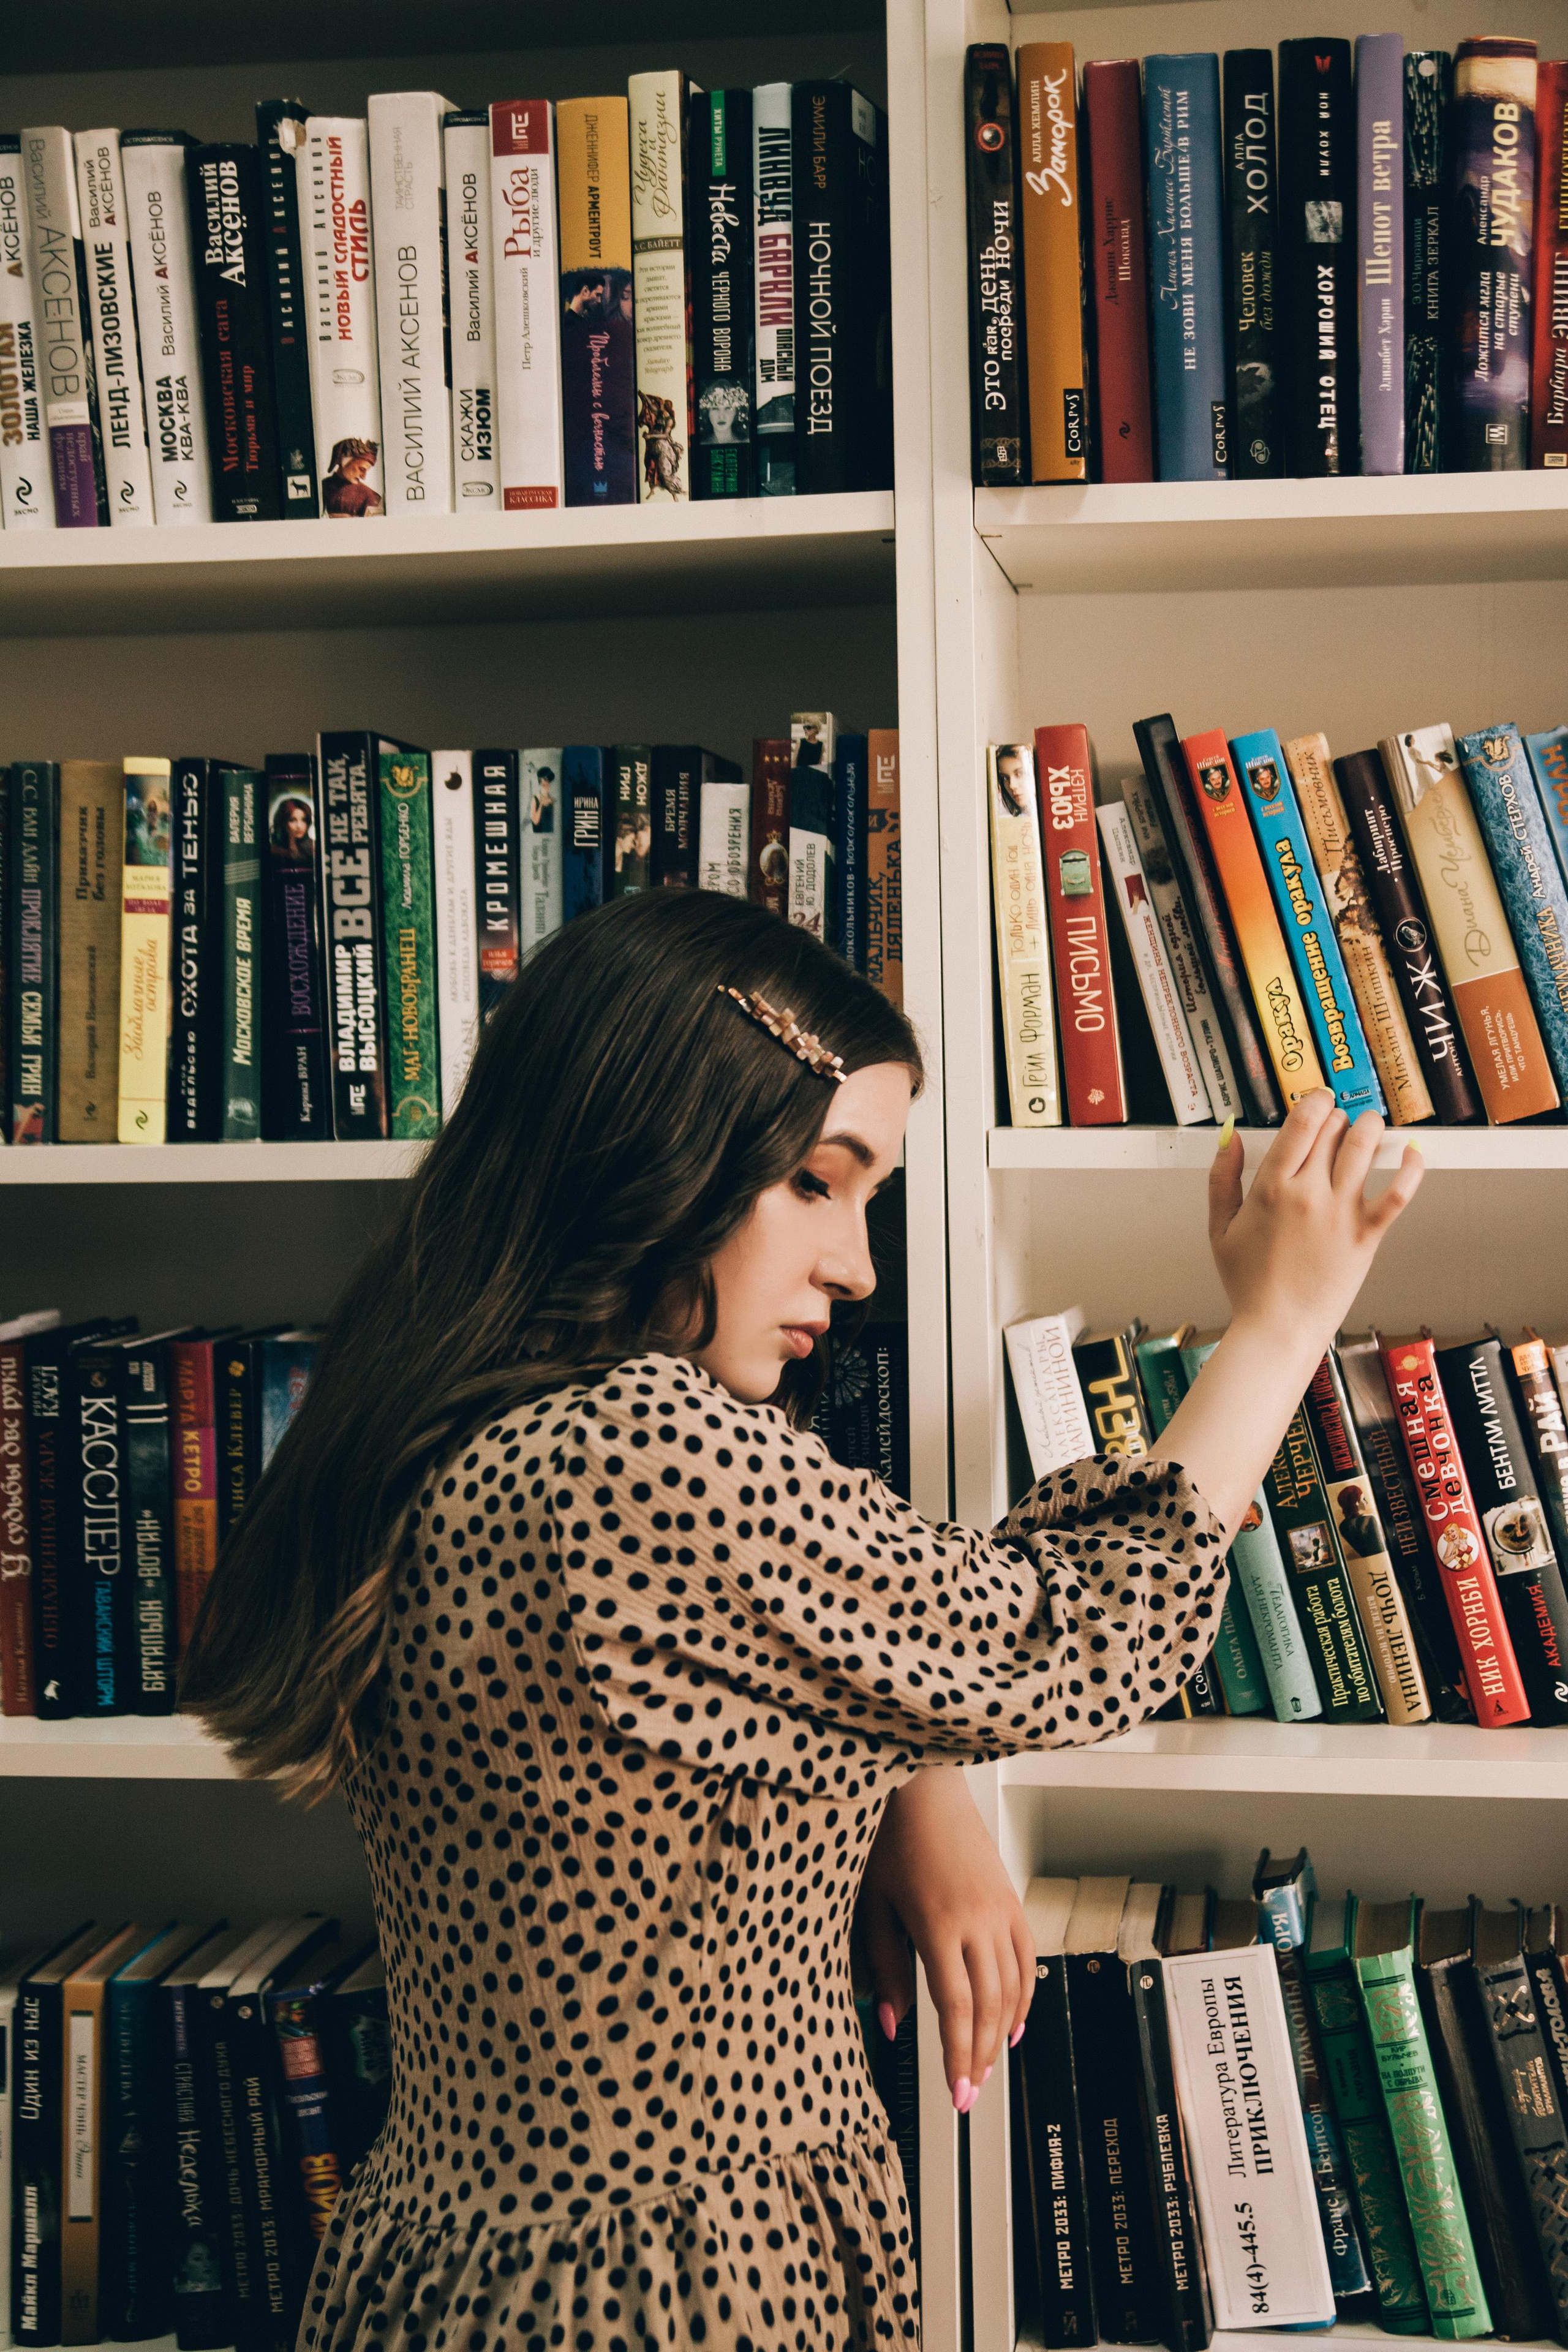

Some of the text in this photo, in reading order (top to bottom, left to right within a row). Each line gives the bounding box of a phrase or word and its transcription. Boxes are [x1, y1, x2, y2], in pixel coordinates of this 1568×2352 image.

[812, 96, 825, 189] ЭМИЛИ БАРР
[1025, 68, 1073, 206] Заморок
[1030, 80, 1042, 163] АЛЛА ХЕМЛИН
[1235, 134, 1244, 170] АЛЛА
[1245, 92, 1270, 214] ХОЛОД
[1491, 102, 1520, 246] ЧУДАКОВ
[84, 160, 100, 228] Василий
[97, 147, 116, 225] АКСЁНОВ
[200, 163, 223, 264] Василий
[328, 137, 353, 341] НОВЫЙ СЛАДОСТНЫЙ
[351, 198, 369, 282] СТИЛЬ
[504, 167, 532, 259] Рыба
[529, 168, 540, 202] люди
[529, 206, 543, 246] другие
[584, 115, 601, 258] ДЖЕННИФЕР АРМЕНТРОУТ
[758, 127, 792, 325] ЛИНВУД БАРКЛИ
[1175, 91, 1197, 369] НЕ ЗОВИ МЕНЯ БОЛЬШЕ В РИМ
[1365, 120, 1396, 286] Шепот ветра
[1476, 176, 1489, 244] Александр
[147, 191, 175, 355] Василий АКСЁНОВ
[462, 173, 481, 342] Василий АКСЁНОВ
[708, 186, 738, 372] Невеста ЧЕРНОГО ВОРОНА
[1118, 219, 1131, 282] Шоколад
[1237, 252, 1256, 331] Человек
[1259, 251, 1274, 331] без дождя
[1427, 206, 1439, 319] КНИГА ЗЕРКАЛ
[1507, 273, 1521, 336] ступени
[94, 242, 131, 447] ЛЕНД-ЛИЗОВСКИЕ
[806, 222, 835, 434] НОЧНОЙ ПОЕЗД
[1316, 265, 1337, 428] ХОРОШИЙ ОТЕЦ
[1474, 271, 1492, 382] Ложится мгла
[1493, 271, 1506, 350] на старые
[18, 322, 40, 440] НАША ЖЕЛЕЗКА
[156, 376, 178, 461] МОСКВА
[175, 376, 194, 461] КВА-КВА
[215, 299, 241, 472] Московская сага
[398, 245, 424, 500] ВАСИЛИЙ АКСЕНОВ
[461, 389, 474, 461] СКАЖИ
[475, 389, 491, 460] ИЗЮМ
[761, 360, 772, 383] ДОМ
[328, 753, 350, 843] НЕ ТАК,
[572, 810, 600, 847] ГРИН
[620, 766, 631, 801] ГРИН
[635, 761, 647, 807] ДЖОН
[665, 788, 676, 832] БРЕМЯ
[1048, 766, 1074, 829] ХРЮЗ
[1071, 768, 1087, 822] КЭТРИН
[1302, 752, 1343, 853] Письмовник
[1377, 804, 1403, 871] Просперо
[1498, 774, 1546, 899] Андрей СТЕРХОВ
[181, 772, 199, 1017] ОХОТА ЗА ТЕНЬЮ
[326, 850, 372, 940] ВСЁ
[483, 765, 510, 931] КРОМЕШНАЯ
[794, 859, 805, 906] ЕВГЕНИЙ
[1364, 810, 1390, 874] Лабиринт
[21, 889, 41, 1095] ПРОКЛЯТИЕ СЕМЬИ ГРИН
[284, 883, 312, 1016] ВОСХОЖДЕНИЕ
[399, 928, 420, 1081] МАГ-НОВОБРАНЕЦ
[1066, 916, 1105, 1031] ПИСЬМО
[1143, 915, 1198, 1096] ЖЕНЩИНЫ НЕПРЕКЛОННОГО ВОЗРАСТА
[1162, 914, 1198, 1012] История одной
[1273, 839, 1354, 1072] Возвращение оракула
[335, 944, 355, 1071] ВЛАДИМИР
[353, 944, 377, 1071] ВЫСОЦКИЙ
[1265, 977, 1304, 1072] Оракул
[1359, 946, 1413, 1090] Михаил Шишкин
[1406, 953, 1455, 1060] ЧИЖ
[1448, 1041, 1463, 1077] АНТОН
[1480, 1005, 1509, 1090] УМЕЛАЯ ЛГУНЬЯ,
[1506, 1012, 1526, 1071] ЧТО ТАНЦУЕШЬ
[1200, 1019, 1232, 1107] БОРИС ШАПИРО-ТУЛИН
[41, 1366, 59, 1417] КАСЛ
[1470, 1357, 1518, 1489] БЕНТЛИ ЛИТТЛ
[1531, 1391, 1566, 1452] РАЙ
[80, 1395, 120, 1575] КАССЛЕР
[183, 1431, 201, 1493] КЕТРО
[1371, 1428, 1419, 1556] НЕИЗВЕСТНЫЙ
[1395, 1382, 1449, 1522] Смешная
[1227, 1636, 1248, 1679] ОЛЬГА
[1304, 1585, 1348, 1707] Практическая работа
[1327, 1578, 1370, 1702] по обитателям болота
[1368, 1571, 1422, 1711] ДОЧЬ ЛЕНИНА
[1455, 1576, 1506, 1696] НИК ХОРНБИ
[20, 1997, 42, 2119] Один из нас
[1201, 1977, 1247, 2178] Литература Европы
[1224, 1976, 1274, 2174] ПРИКЛЮЧЕНИЯ
[245, 2077, 284, 2313] МЕТРО 2033: МРАМОРНЫЙ РАЙ
[1048, 2124, 1074, 2289] МЕТРО 2033: ПИФИЯ-2
[1104, 2118, 1134, 2284] МЕТРО 2033: ПЕРЕХОД
[1156, 2114, 1189, 2291] МЕТРО 2033: РУБЛЕВКА
[20, 2186, 41, 2330] Майкл Маршалл
[1235, 2201, 1270, 2313] 84(4)-445.5
